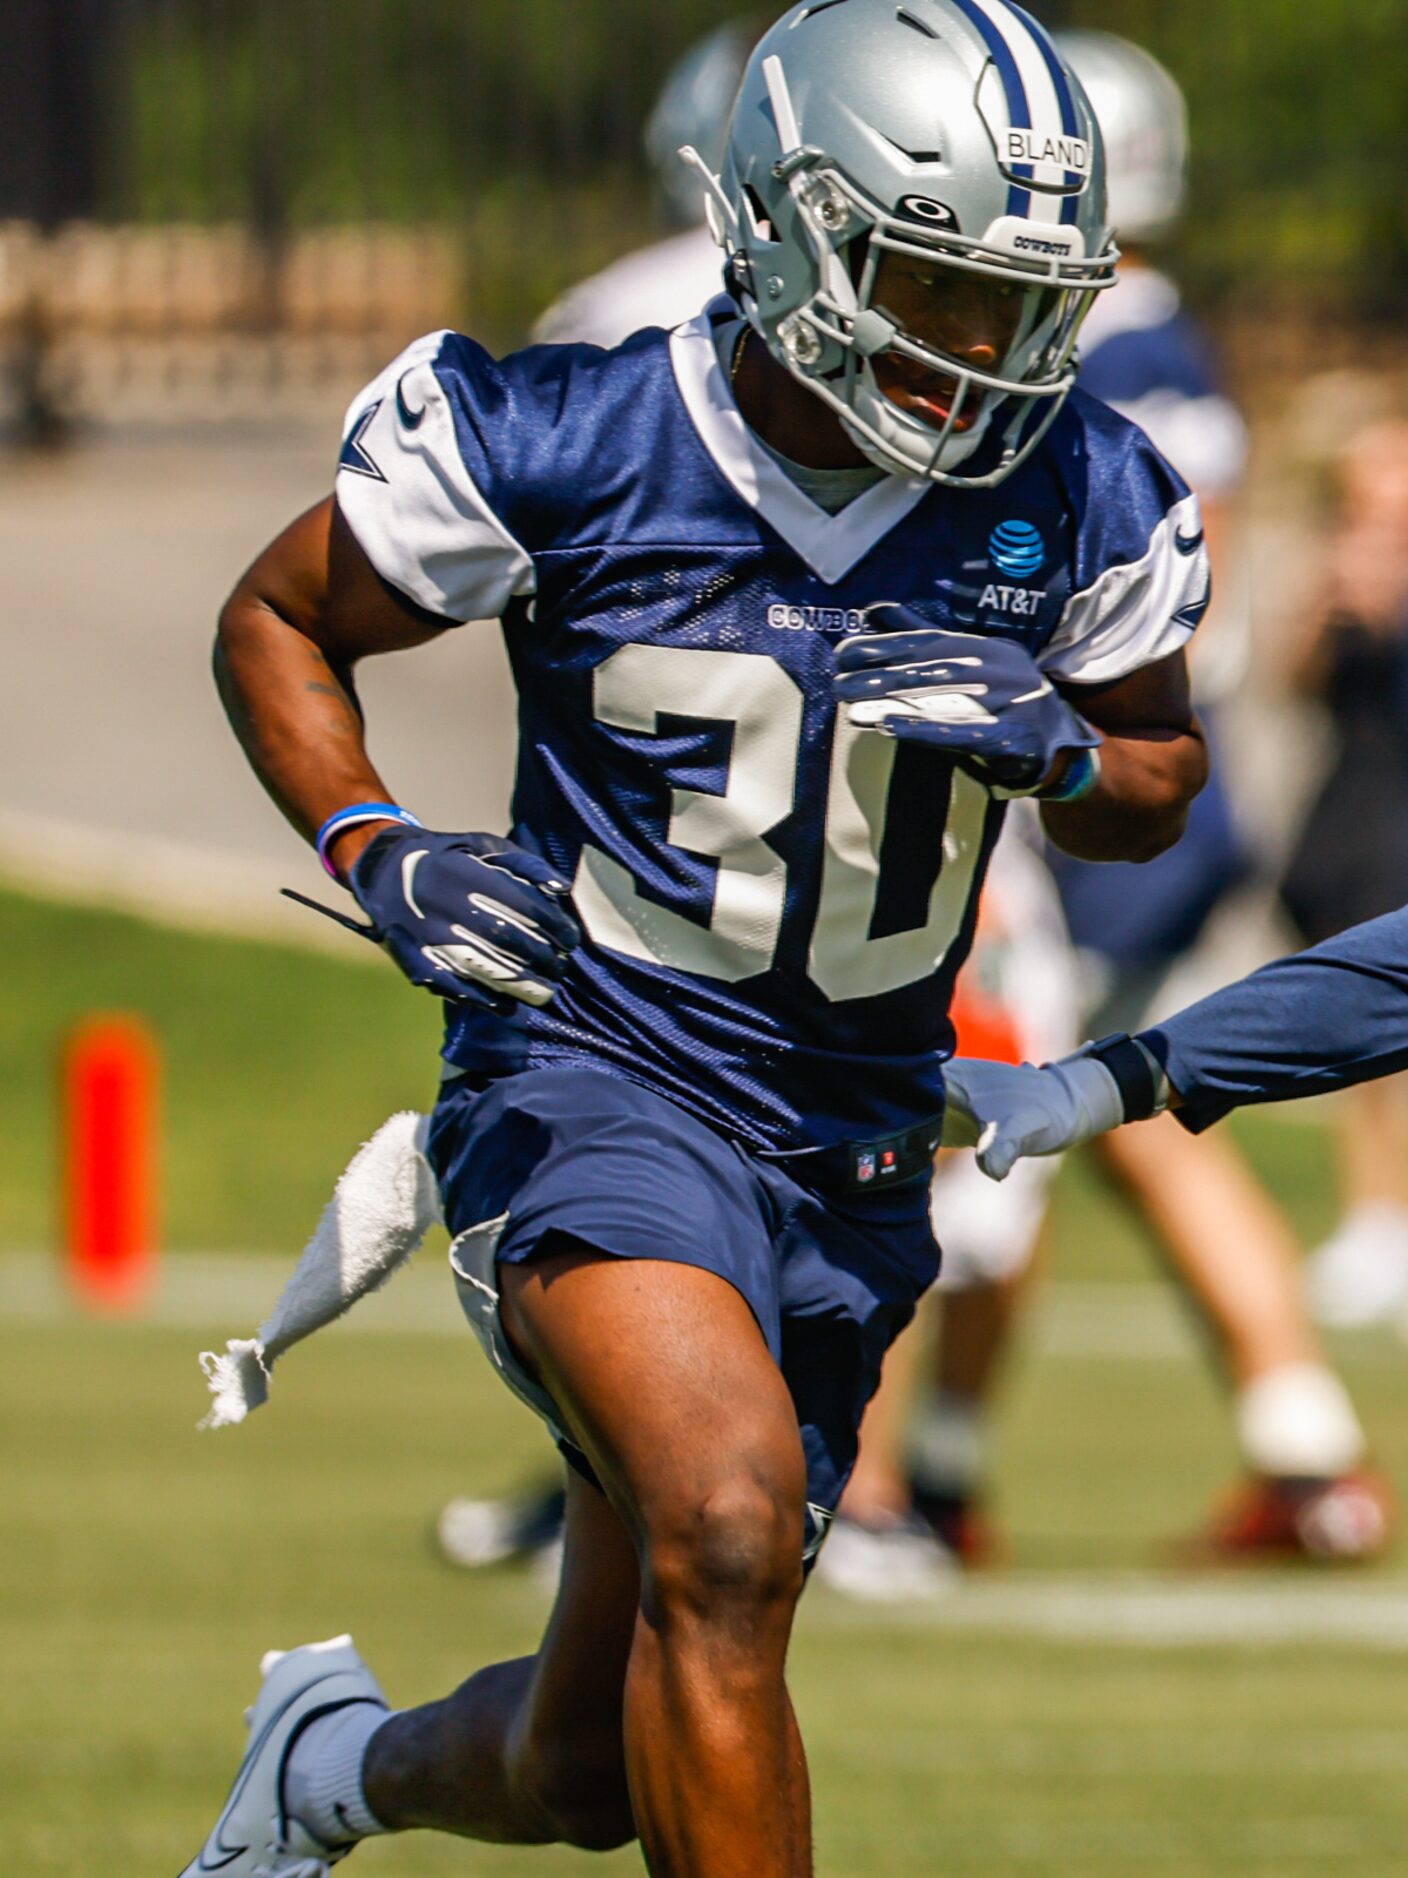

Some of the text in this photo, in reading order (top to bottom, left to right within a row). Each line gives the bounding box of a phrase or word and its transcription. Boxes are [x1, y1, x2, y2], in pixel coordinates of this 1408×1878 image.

[1007, 133, 1086, 169] BLAND
[1013, 235, 1072, 257] COWBOYS
[977, 583, 1047, 616] AT&T
[570, 643, 990, 1002] 30
